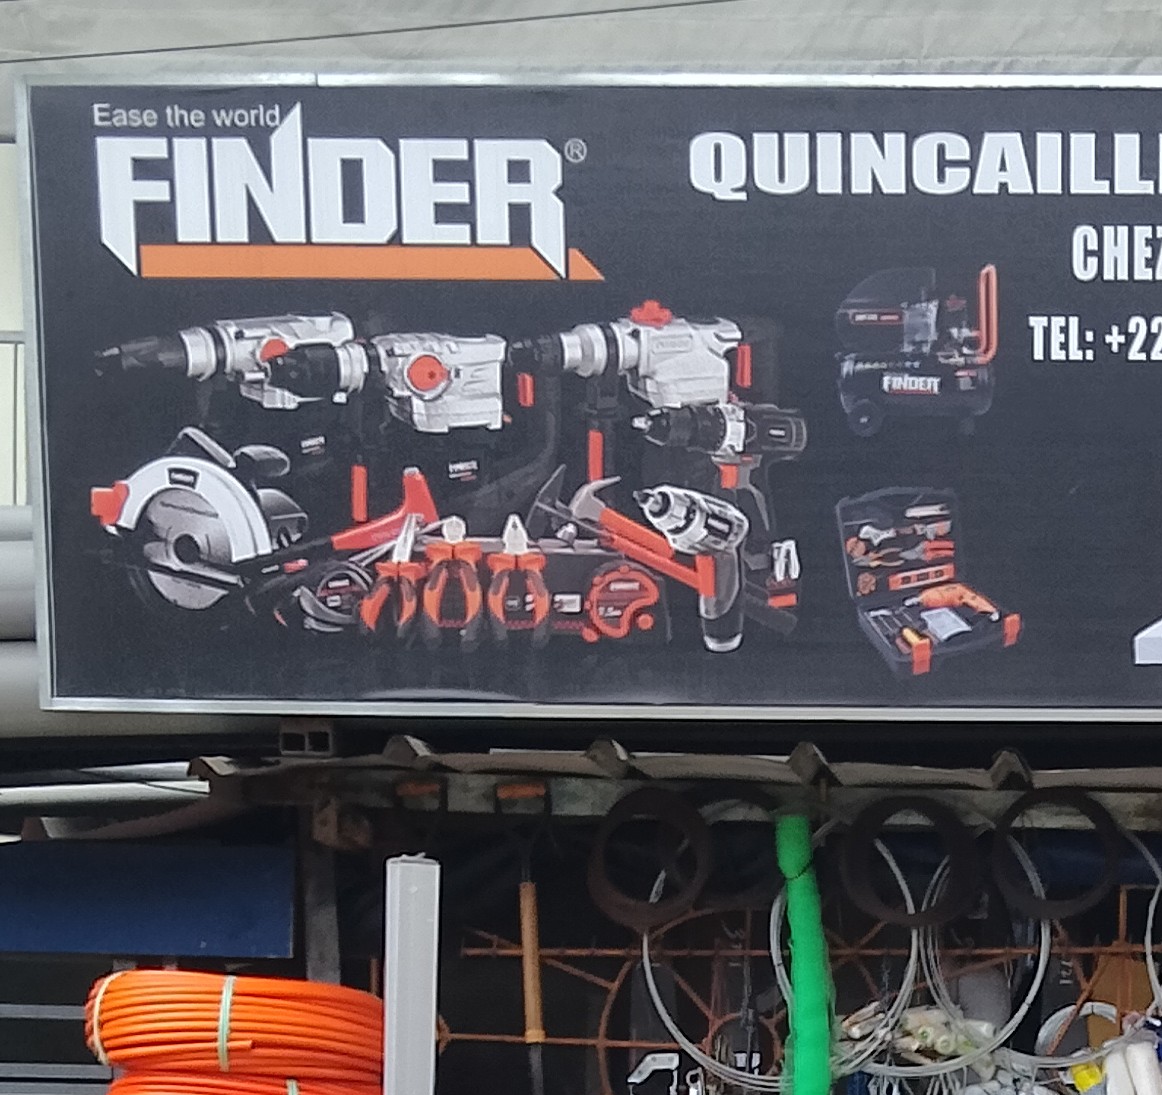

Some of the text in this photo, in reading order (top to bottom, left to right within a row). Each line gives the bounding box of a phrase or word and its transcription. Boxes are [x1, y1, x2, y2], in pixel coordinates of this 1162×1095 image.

[91, 103, 281, 128] Ease the world
[95, 102, 567, 279] FINDER
[1027, 316, 1095, 362] TEL:
